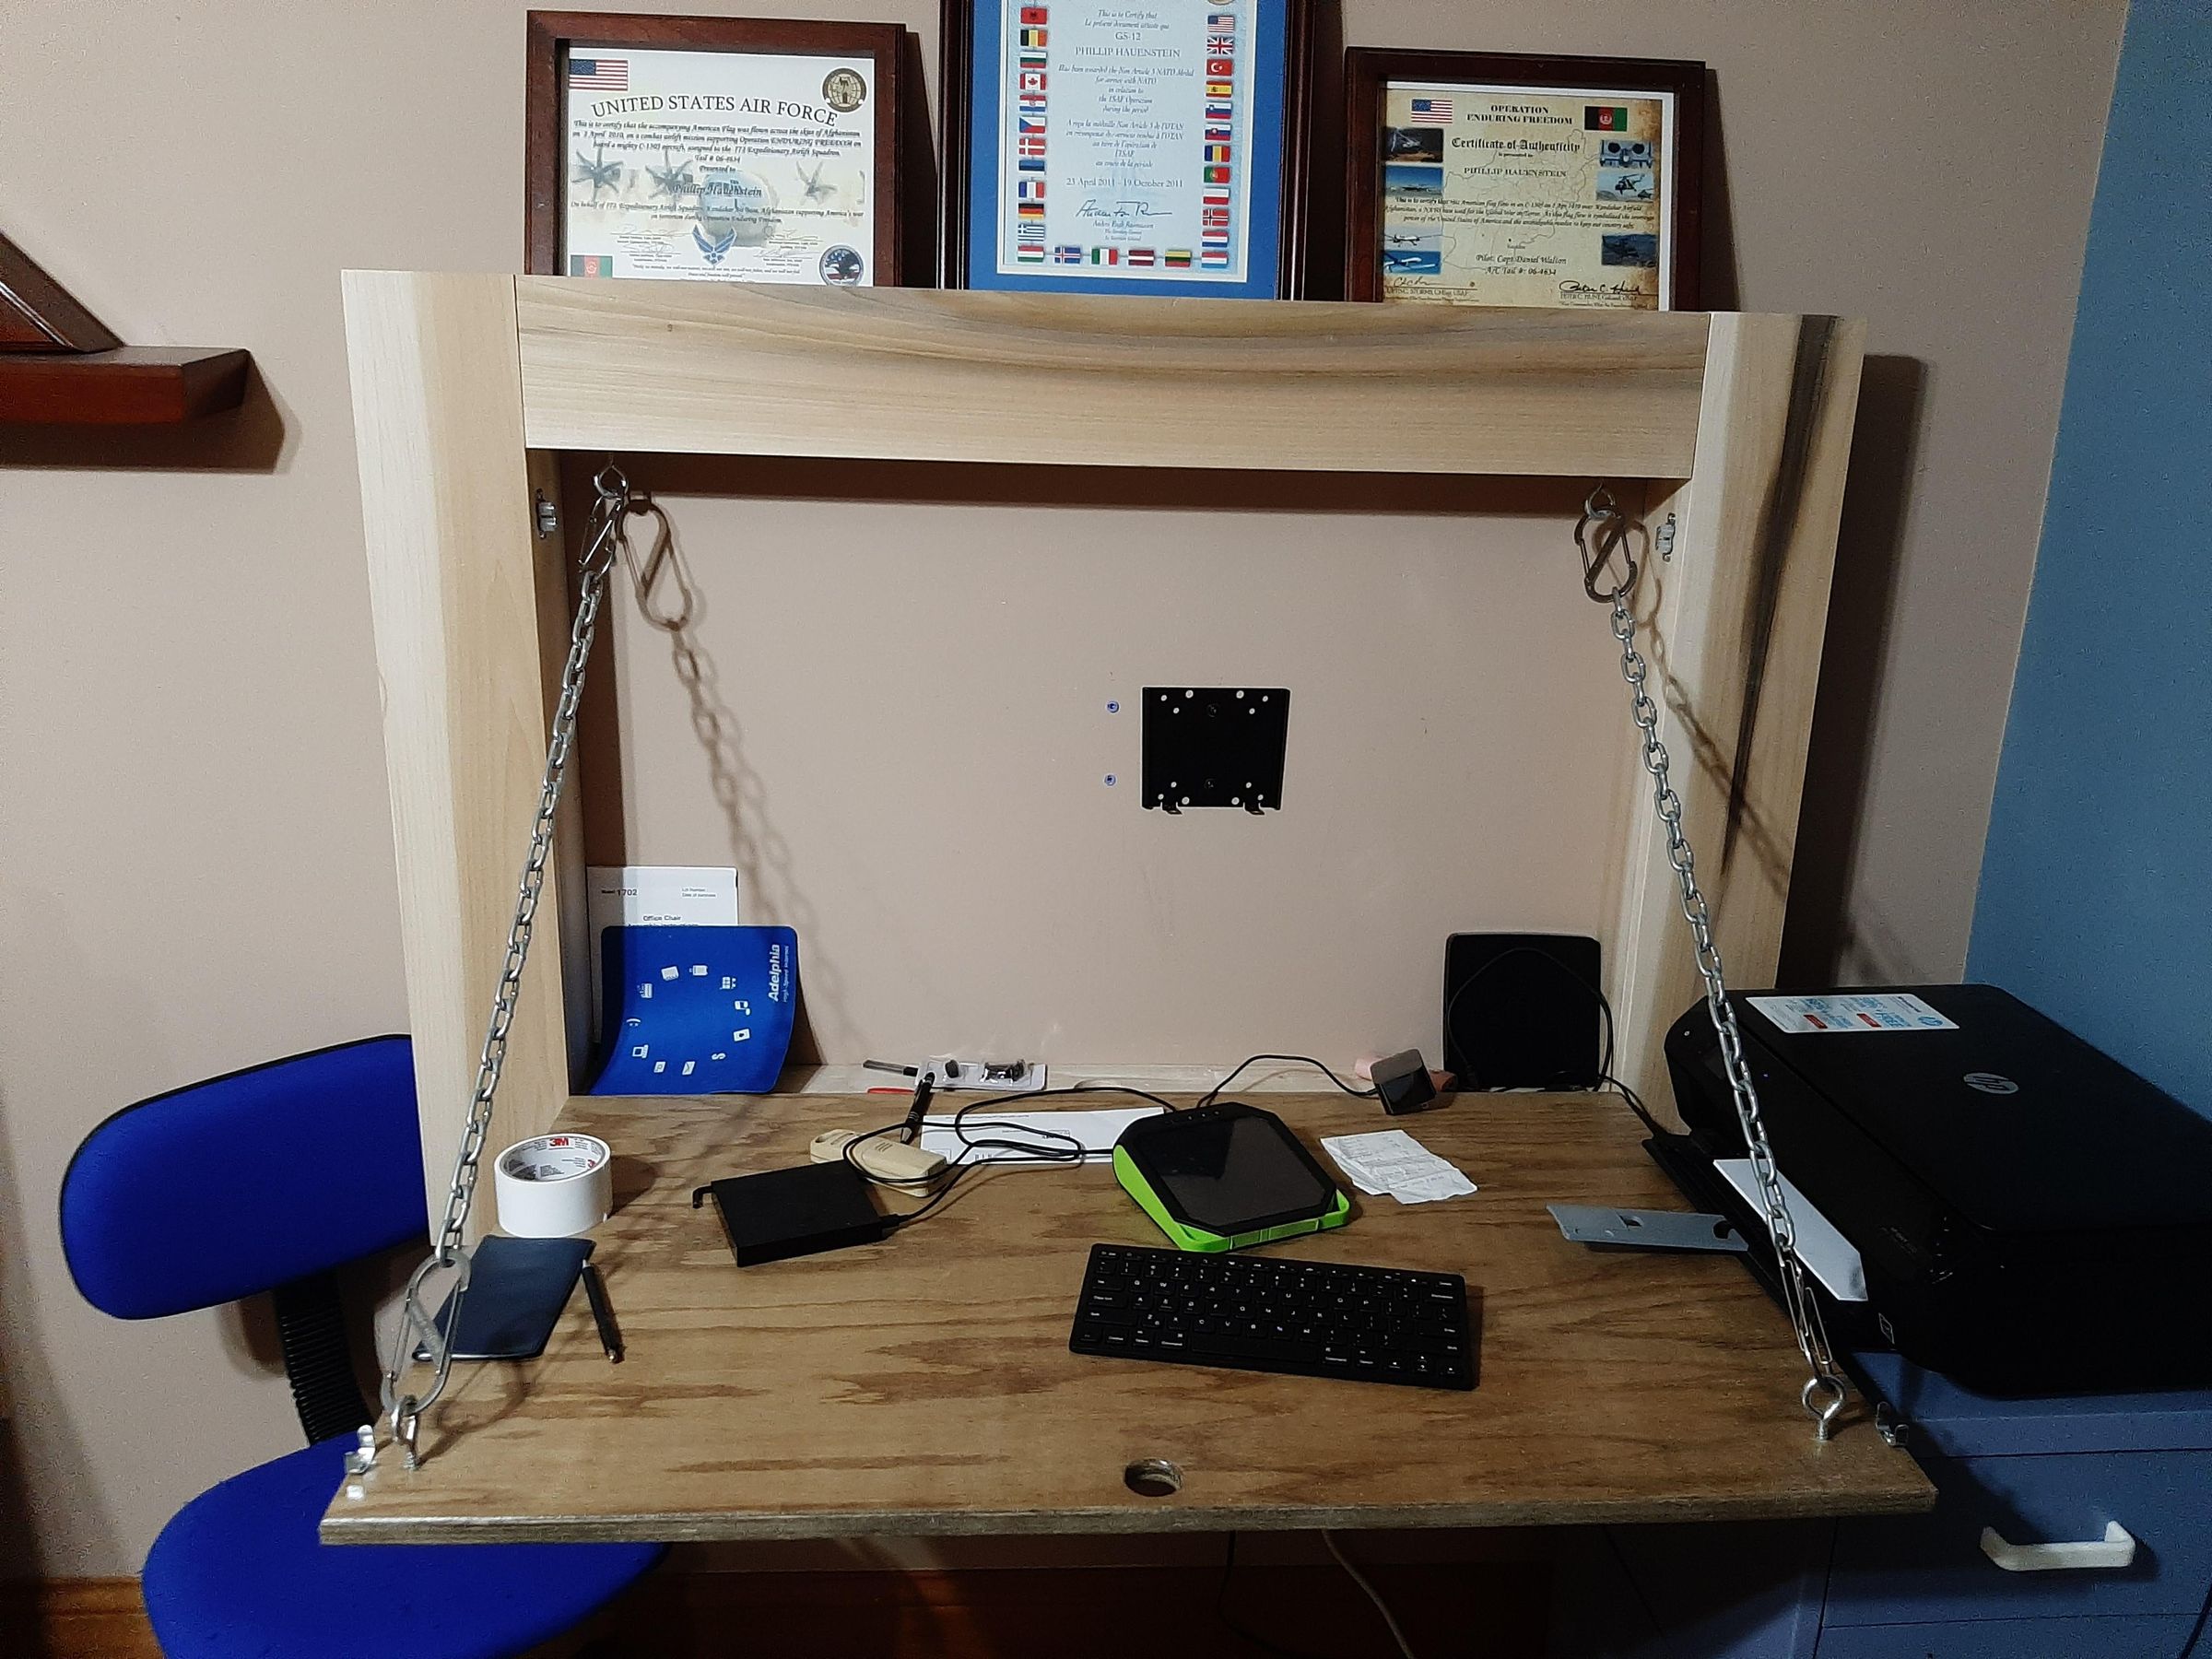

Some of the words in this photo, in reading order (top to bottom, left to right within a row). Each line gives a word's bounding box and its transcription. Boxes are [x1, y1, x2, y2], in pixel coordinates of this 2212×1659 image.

[1115, 31, 1141, 41] GS-12
[1076, 46, 1113, 56] PHILLIP
[1116, 48, 1181, 58] HAUENSTEIN
[592, 96, 663, 117] UNITED
[669, 96, 735, 111] STATES
[739, 98, 771, 113] AIR
[777, 101, 838, 126] FORCE
[1491, 105, 1548, 114] OPERATION
[1467, 114, 1521, 123] ENDURING
[1524, 116, 1572, 124] FREEDOM
[1452, 137, 1504, 149] Certificate
[1507, 139, 1516, 149] of
[1520, 139, 1581, 153] Authenticity
[1505, 168, 1567, 178] HAUENSTEIN
[1077, 178, 1096, 188] April
[768, 945, 782, 1002] Adelphia
[549, 1137, 569, 1147] 3M
